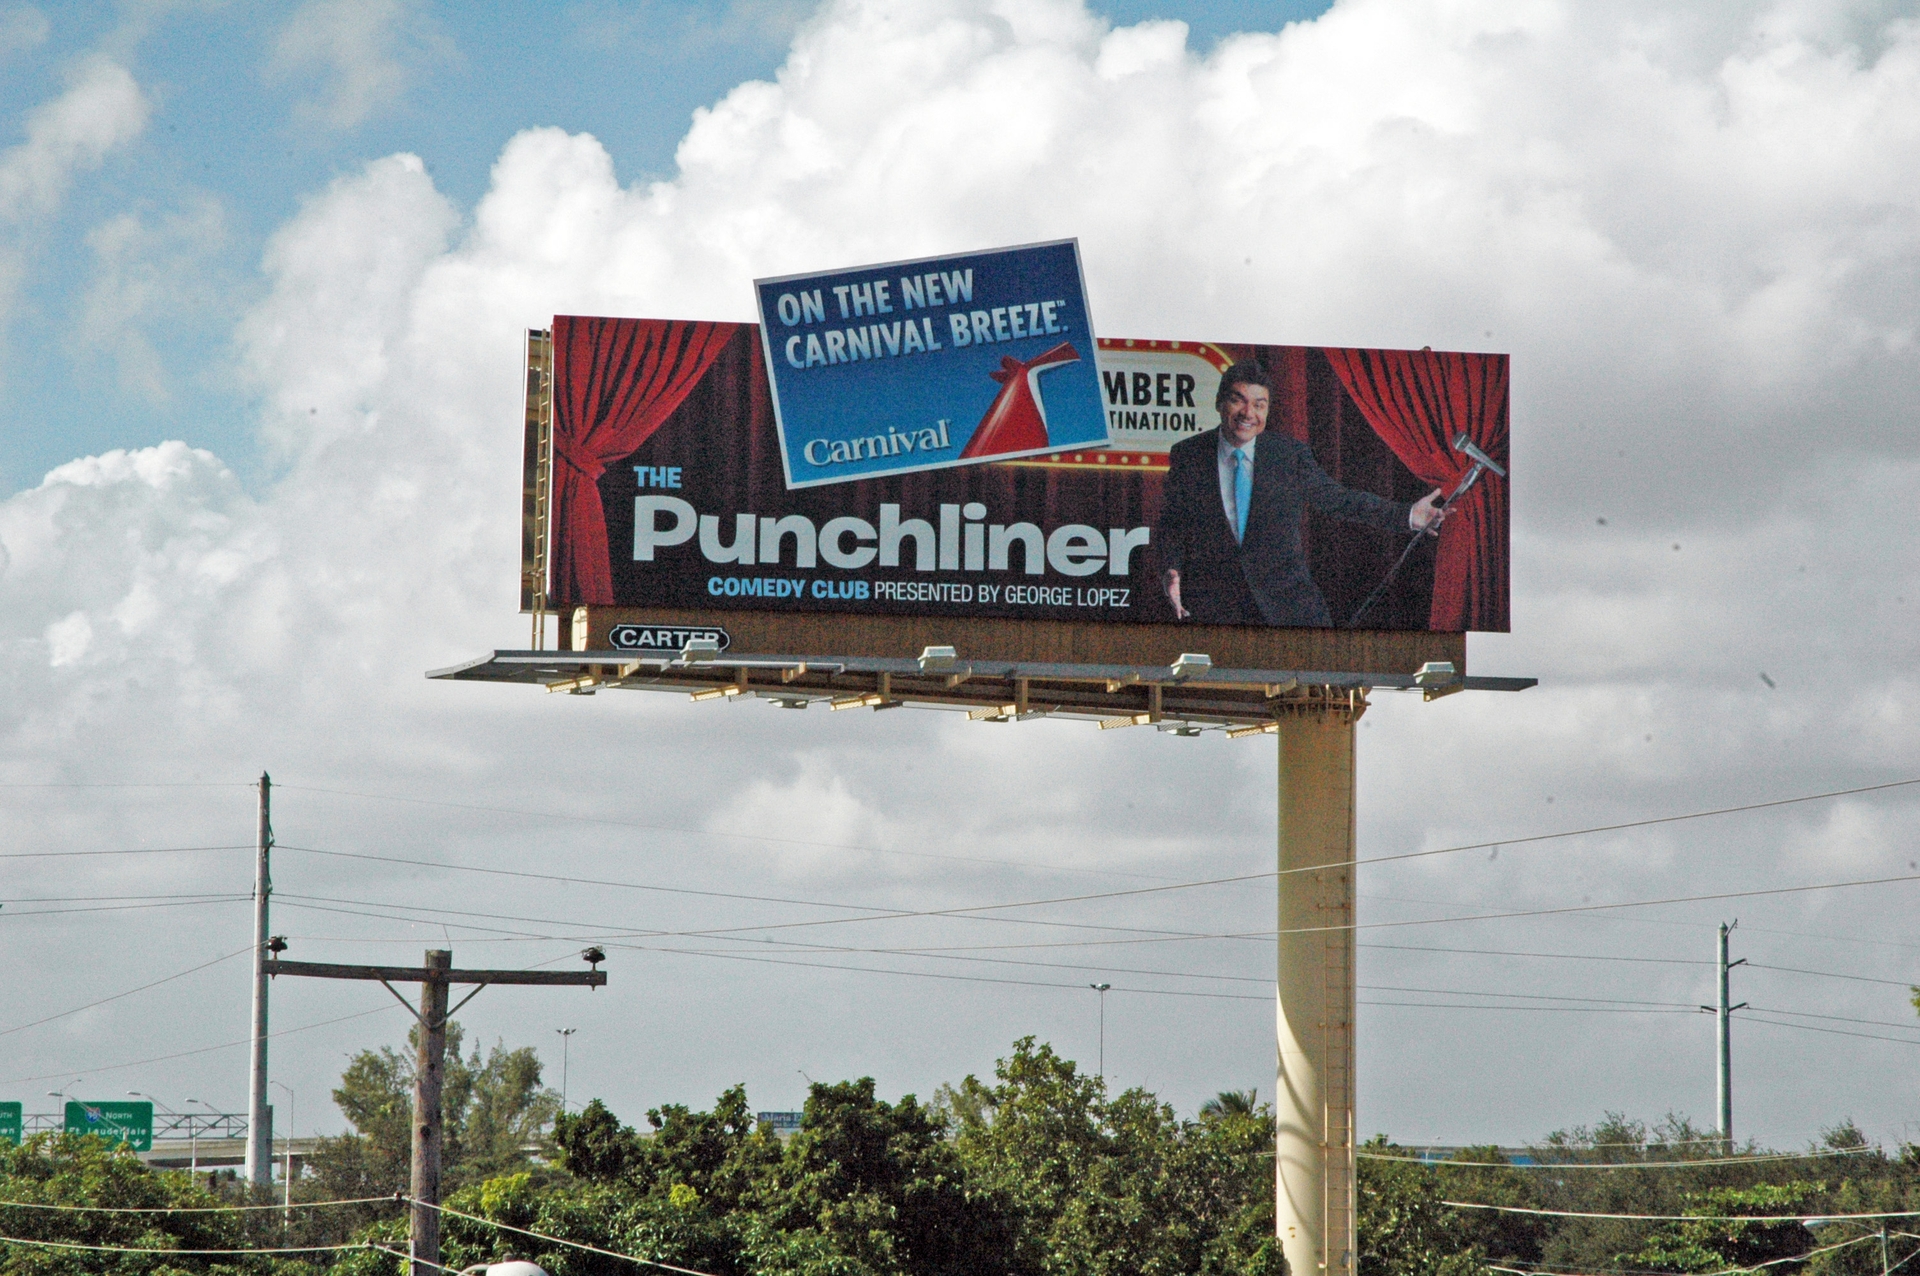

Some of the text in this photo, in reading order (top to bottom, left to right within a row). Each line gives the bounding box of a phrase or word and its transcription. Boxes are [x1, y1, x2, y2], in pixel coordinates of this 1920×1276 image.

[778, 268, 974, 327] ON THE NEW
[785, 319, 942, 370] CARNIVAL
[804, 418, 952, 468] Carnival
[633, 466, 682, 489] THE
[633, 495, 1150, 577] Punchliner
[708, 577, 1130, 607] COMEDY CLUB PRESENTED BY GEORGE LOPEZ
